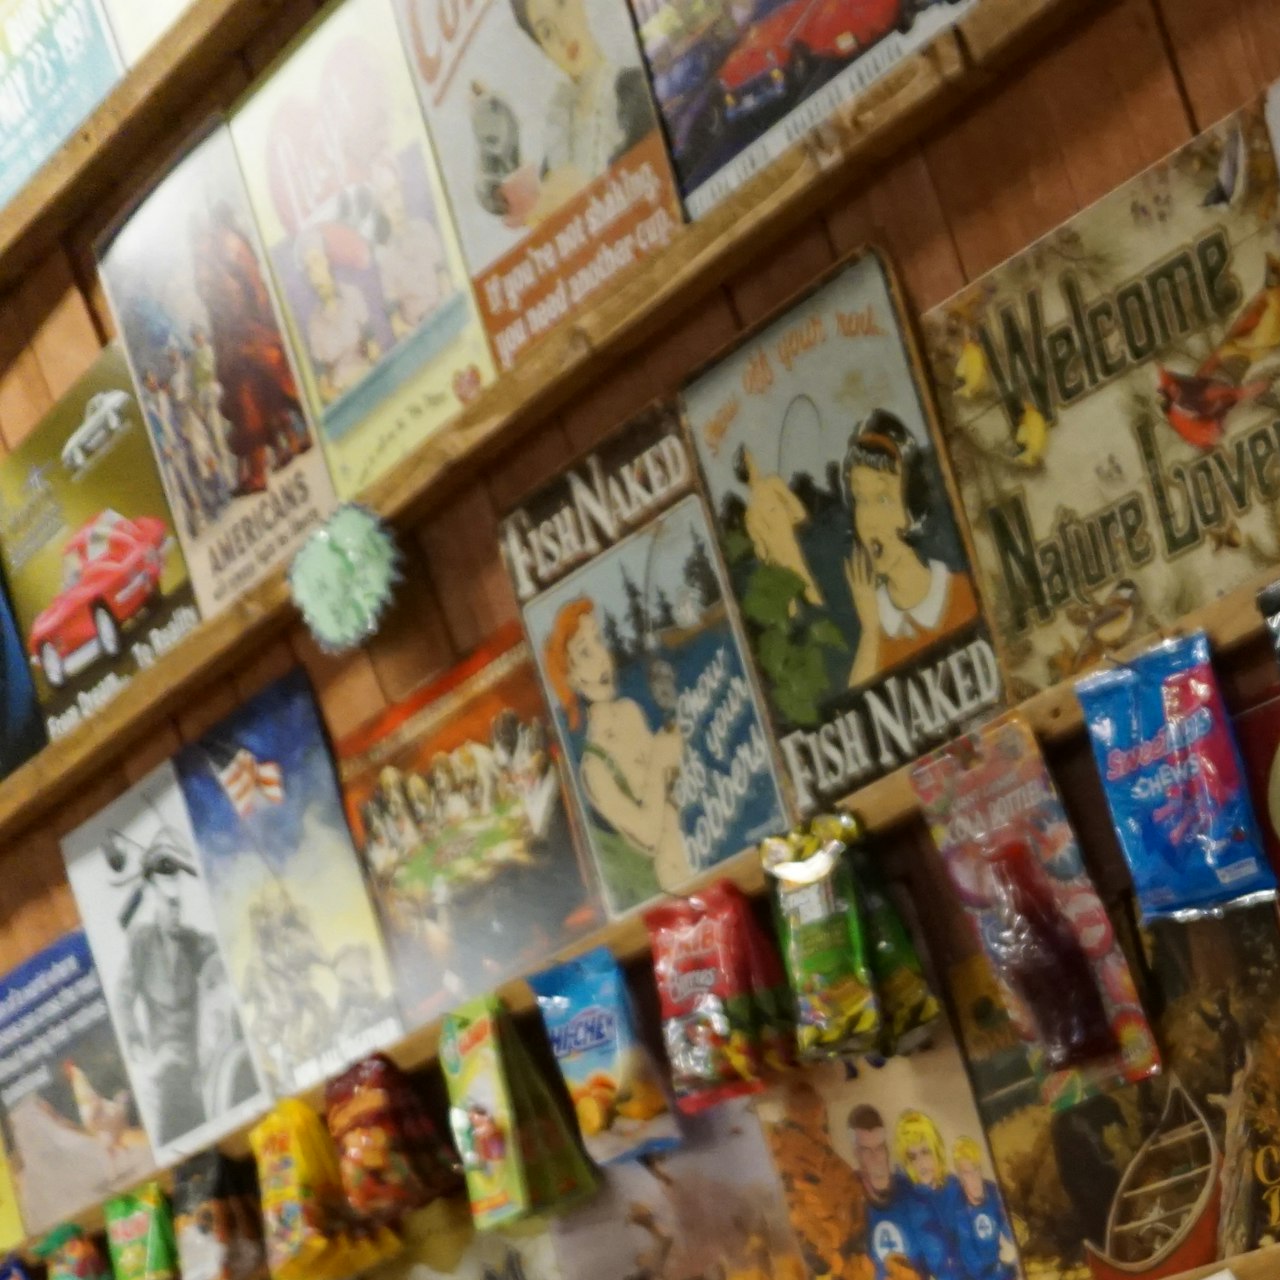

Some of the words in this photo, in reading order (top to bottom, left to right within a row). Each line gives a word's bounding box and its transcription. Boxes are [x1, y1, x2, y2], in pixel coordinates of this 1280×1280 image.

[978, 223, 1245, 429] Welcome
[503, 503, 585, 600] FISH
[566, 433, 691, 551] NAKED
[986, 486, 1154, 635] Nature
[780, 711, 872, 814] FISH
[864, 638, 1000, 760] NAKED
